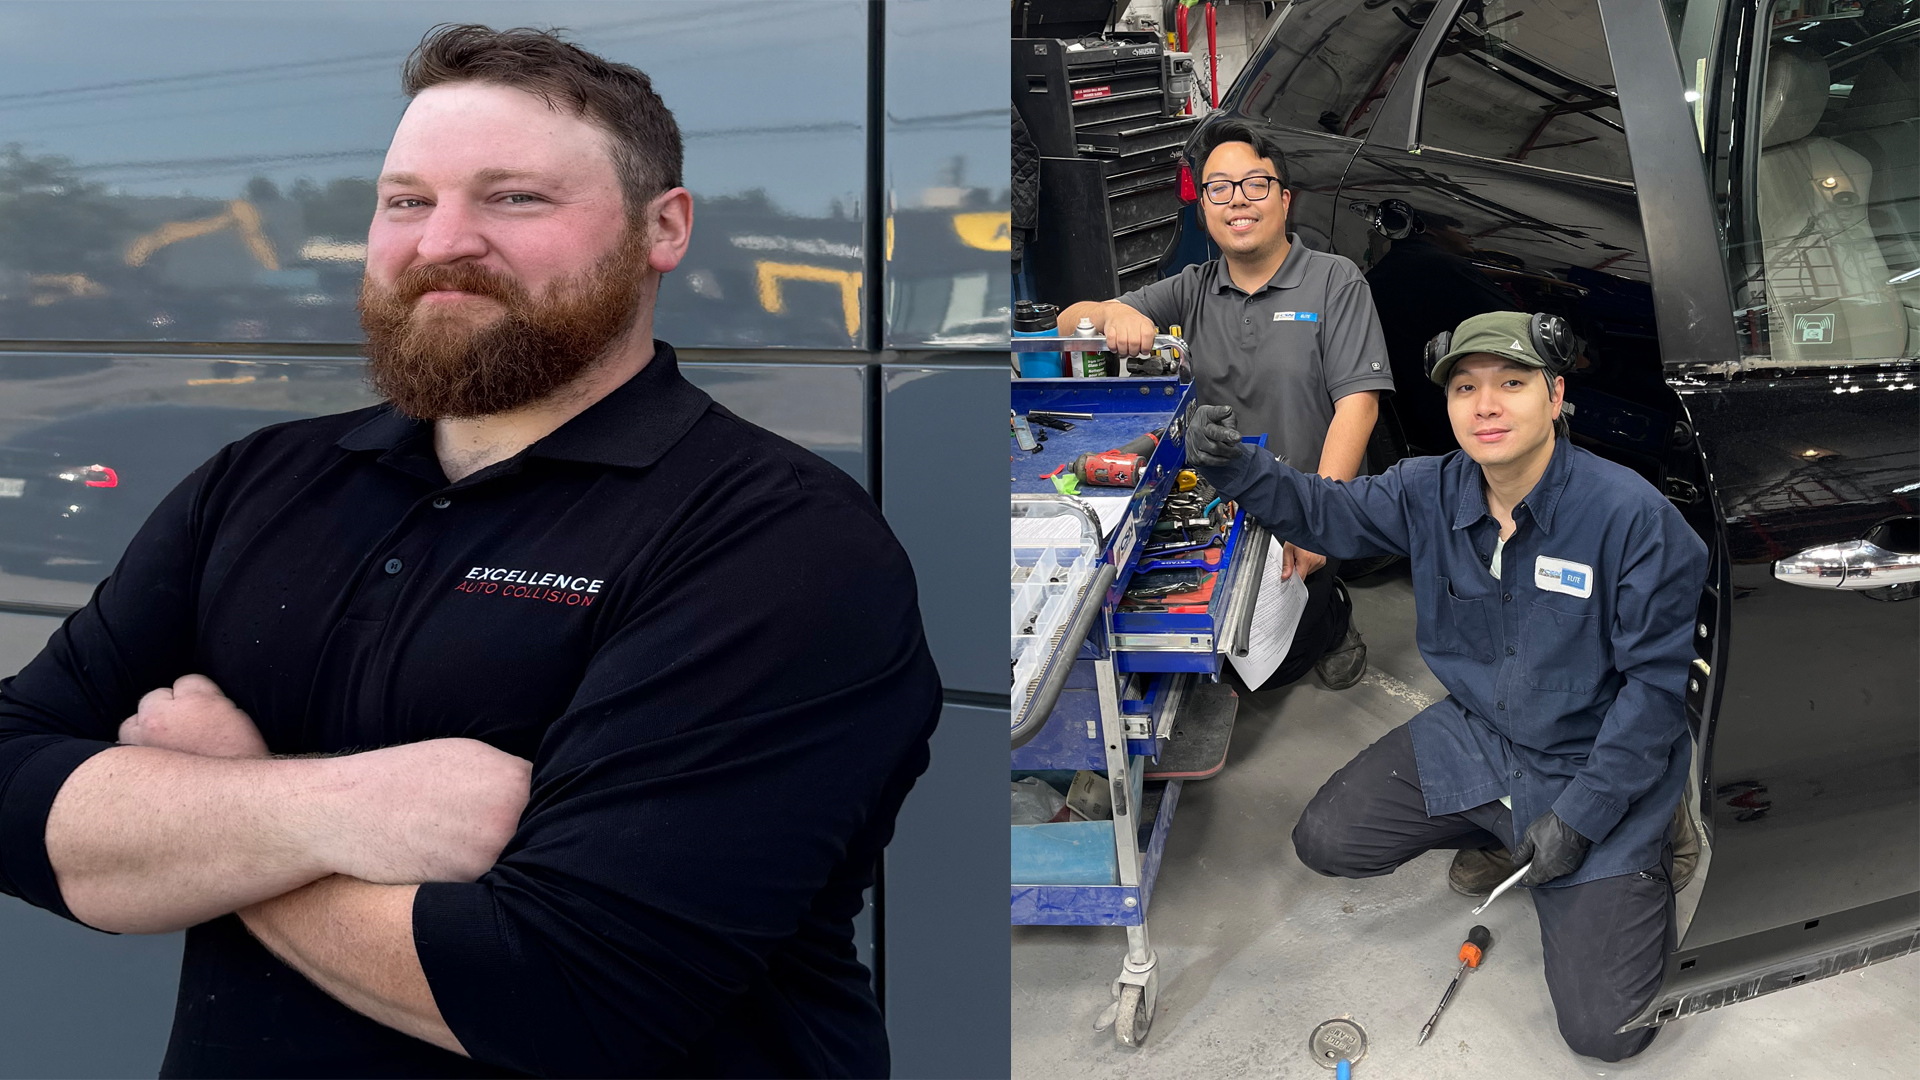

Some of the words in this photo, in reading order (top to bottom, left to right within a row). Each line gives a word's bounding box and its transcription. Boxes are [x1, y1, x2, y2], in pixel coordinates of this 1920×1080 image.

[1138, 47, 1157, 56] HUSKY
[465, 567, 604, 593] EXCELLENCE
[1567, 574, 1582, 584] ELITE
[454, 580, 499, 594] AUTO
[502, 585, 596, 607] COLLISION
[1329, 1028, 1357, 1044] CLAMP
